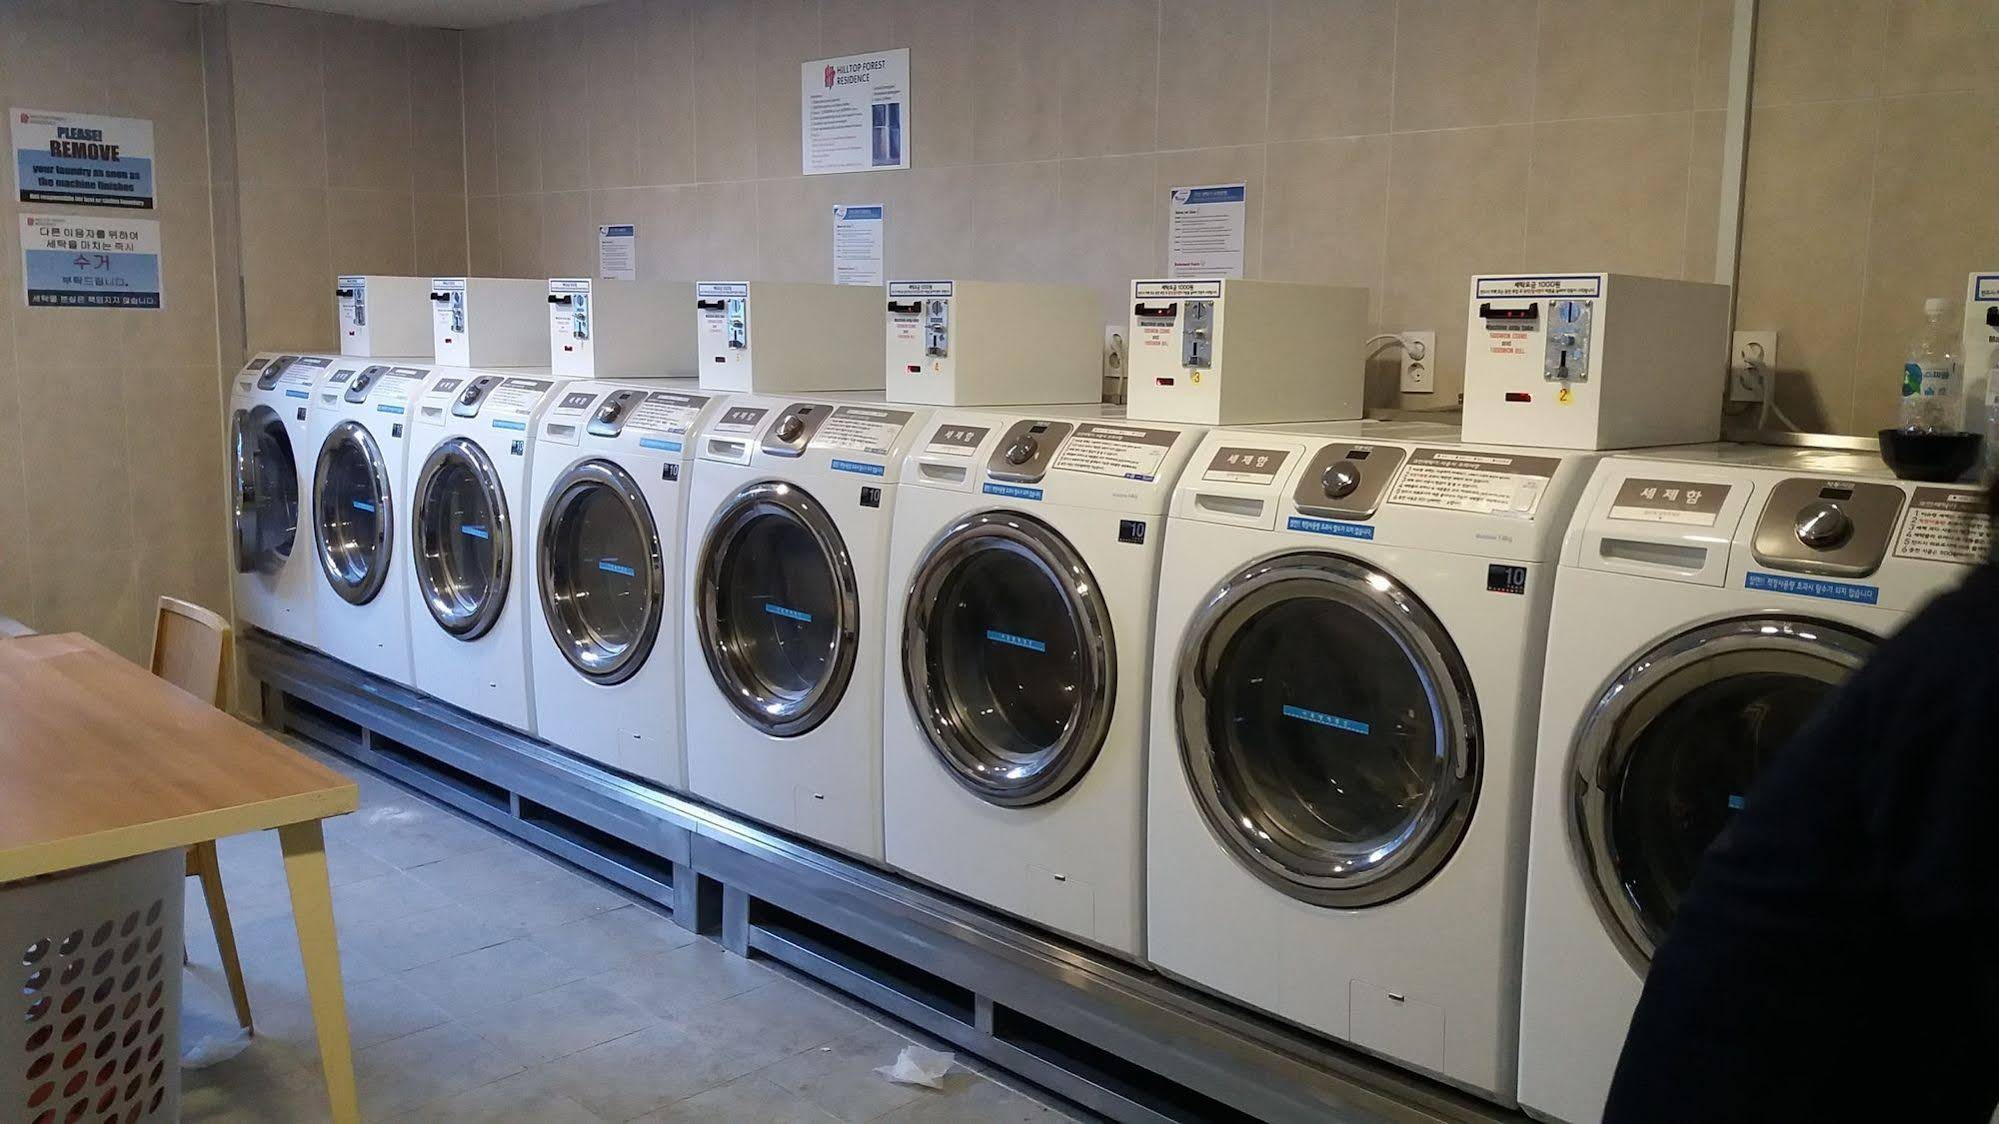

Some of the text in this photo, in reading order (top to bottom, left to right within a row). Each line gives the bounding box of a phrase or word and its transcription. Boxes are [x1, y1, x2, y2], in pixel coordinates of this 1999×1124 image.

[837, 60, 886, 74] HILLTOP FOREST
[837, 73, 870, 85] RESIDENCE
[57, 127, 102, 141] PLEASE!
[50, 140, 120, 161] REMOVE
[33, 165, 54, 173] your
[56, 166, 91, 177] laundry
[105, 171, 127, 179] soon
[38, 178, 134, 191] the machine finishes
[40, 228, 139, 240] 다른 이용자를 위하여
[46, 240, 134, 251] 세탁을 마치는 즉시
[73, 254, 110, 271] 수거
[1560, 389, 1568, 401] 2
[870, 489, 880, 501] 10
[1131, 522, 1145, 537] 10
[1505, 568, 1525, 585] 10
